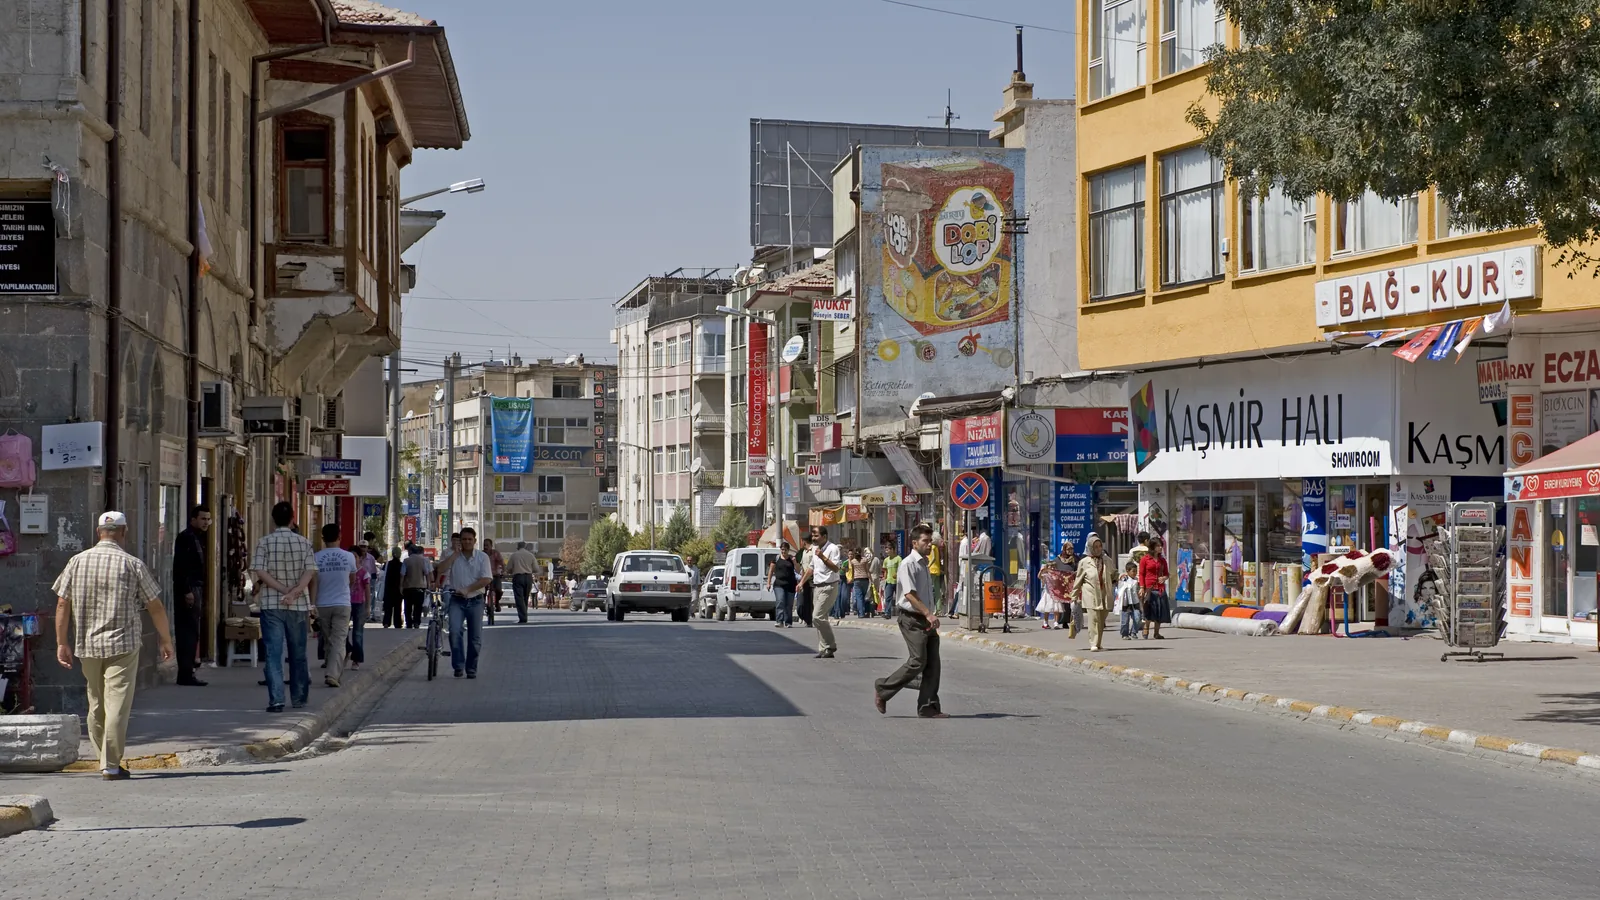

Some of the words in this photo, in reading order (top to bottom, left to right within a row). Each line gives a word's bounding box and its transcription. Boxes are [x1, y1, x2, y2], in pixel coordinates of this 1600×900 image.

[951, 239, 991, 265] LOP
[813, 299, 851, 311] AVUKAT
[812, 311, 832, 319] Hüseyin
[1544, 349, 1600, 384] ECZA
[1480, 383, 1501, 399] DOĞUŞ
[1165, 387, 1264, 459] KAŞMİR
[1281, 393, 1343, 447] HALI
[967, 428, 996, 441] NİZAM
[1331, 450, 1381, 469] SHOWROOM
[1511, 394, 1534, 618] ECANE
